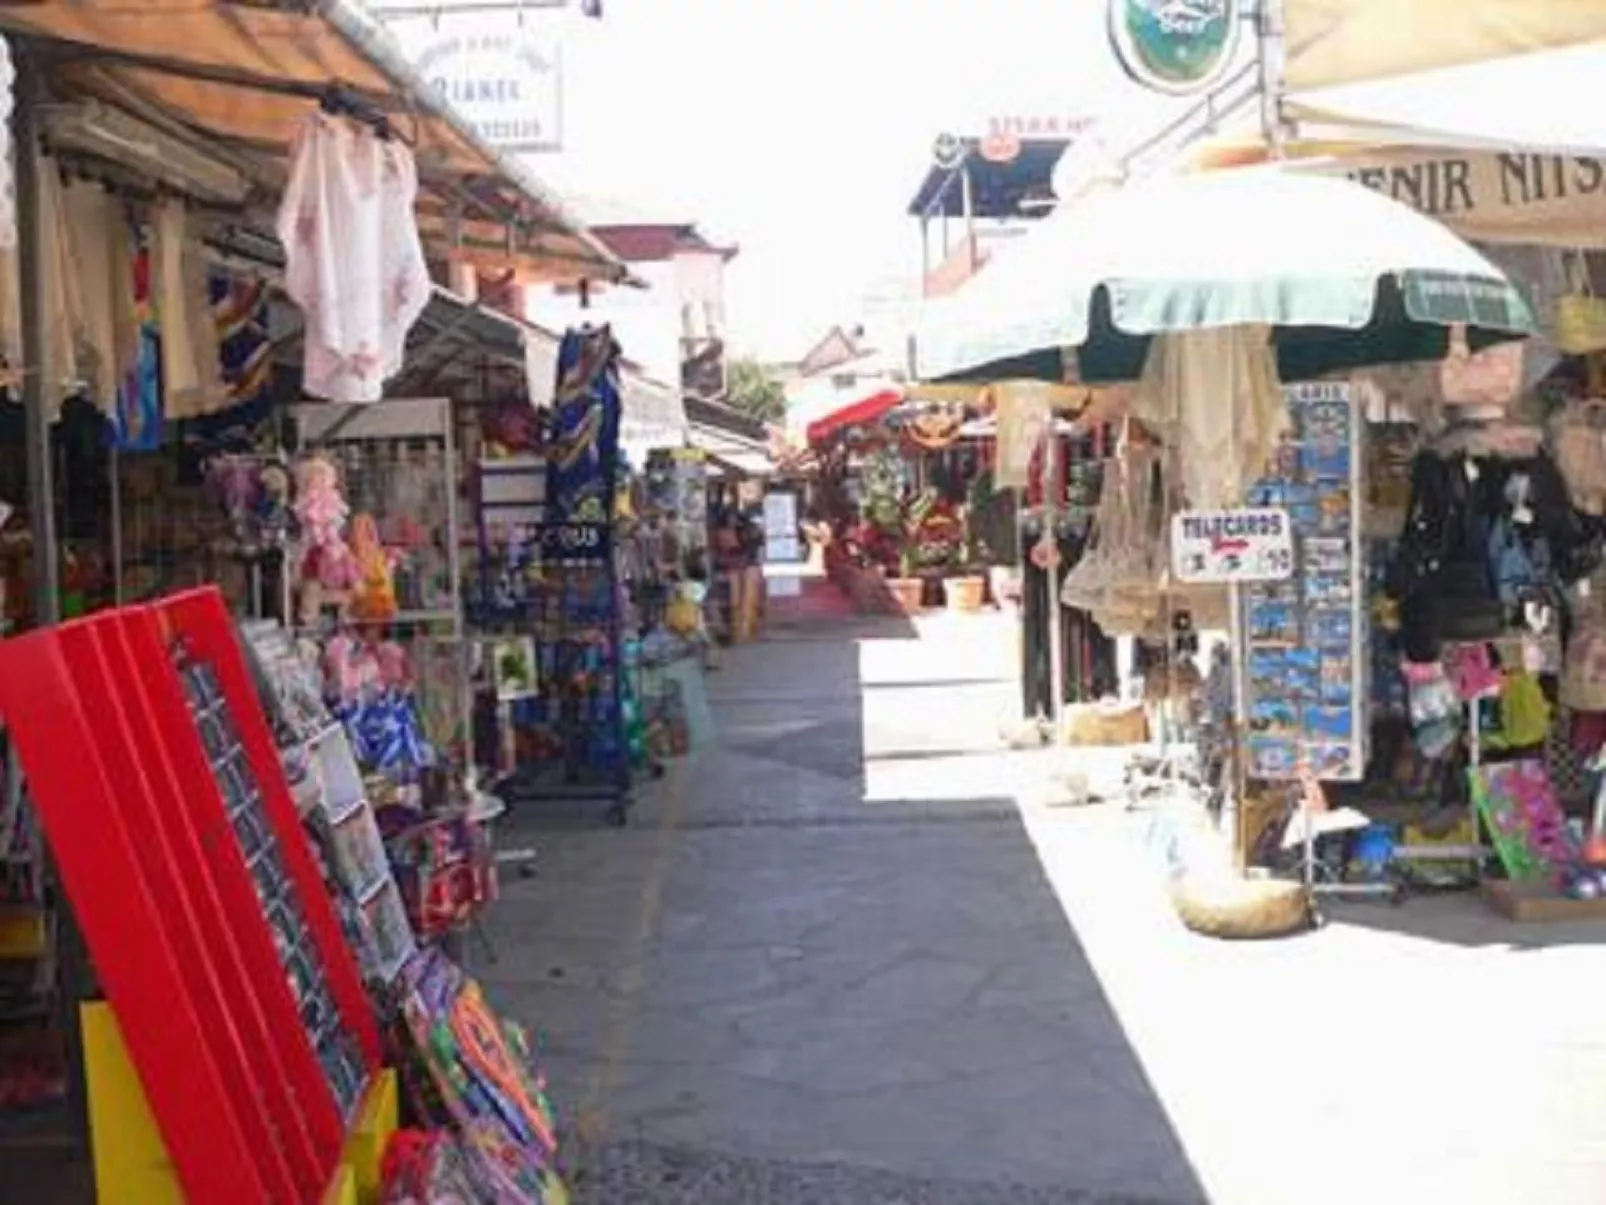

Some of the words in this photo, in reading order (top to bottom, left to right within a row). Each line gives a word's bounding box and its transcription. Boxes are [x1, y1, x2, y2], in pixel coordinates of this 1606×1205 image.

[1345, 159, 1473, 214] ENIR
[1497, 152, 1606, 205] NITS
[1182, 514, 1282, 539] TELECARDS
